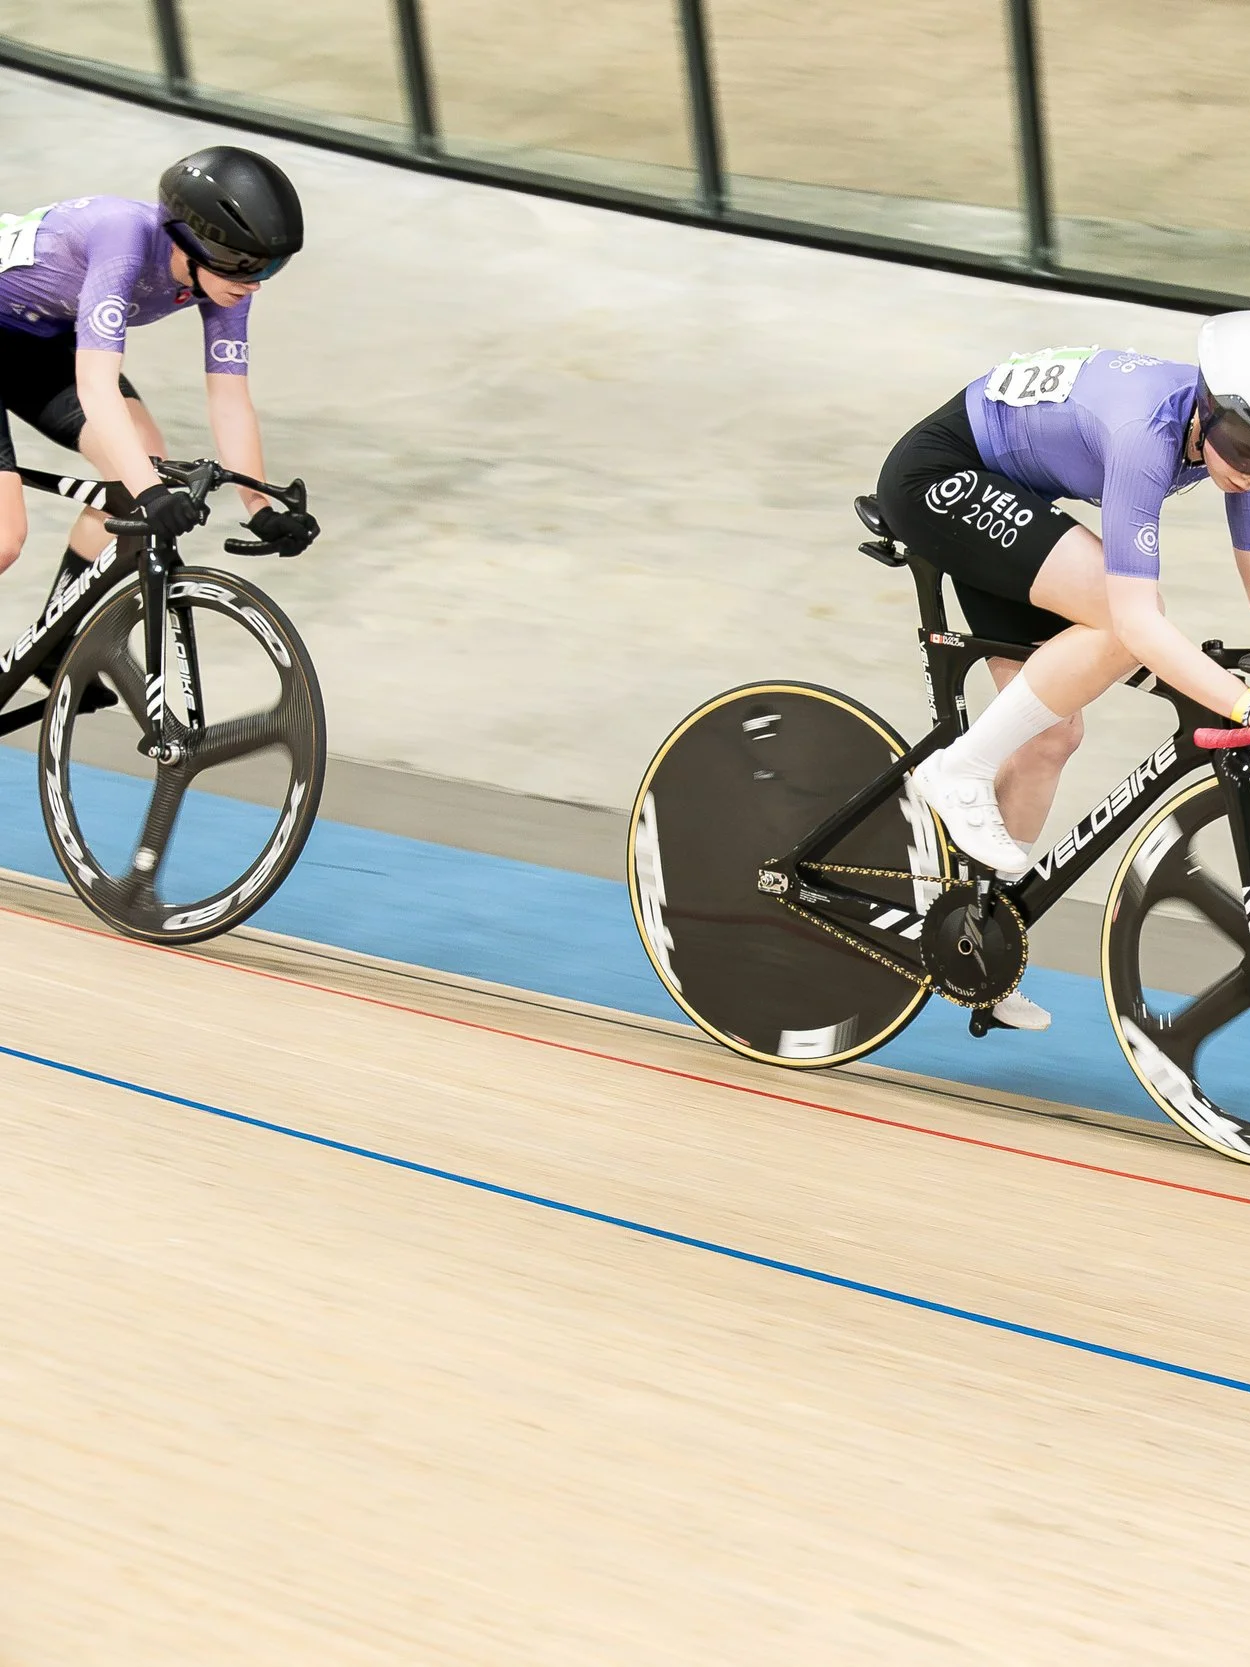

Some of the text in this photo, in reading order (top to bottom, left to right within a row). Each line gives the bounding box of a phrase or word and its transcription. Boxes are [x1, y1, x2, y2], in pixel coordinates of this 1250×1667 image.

[998, 364, 1066, 399] 128
[961, 503, 1018, 548] 2000
[0, 537, 118, 673] VELOBIKE
[1033, 736, 1178, 881] VELOBIKE
